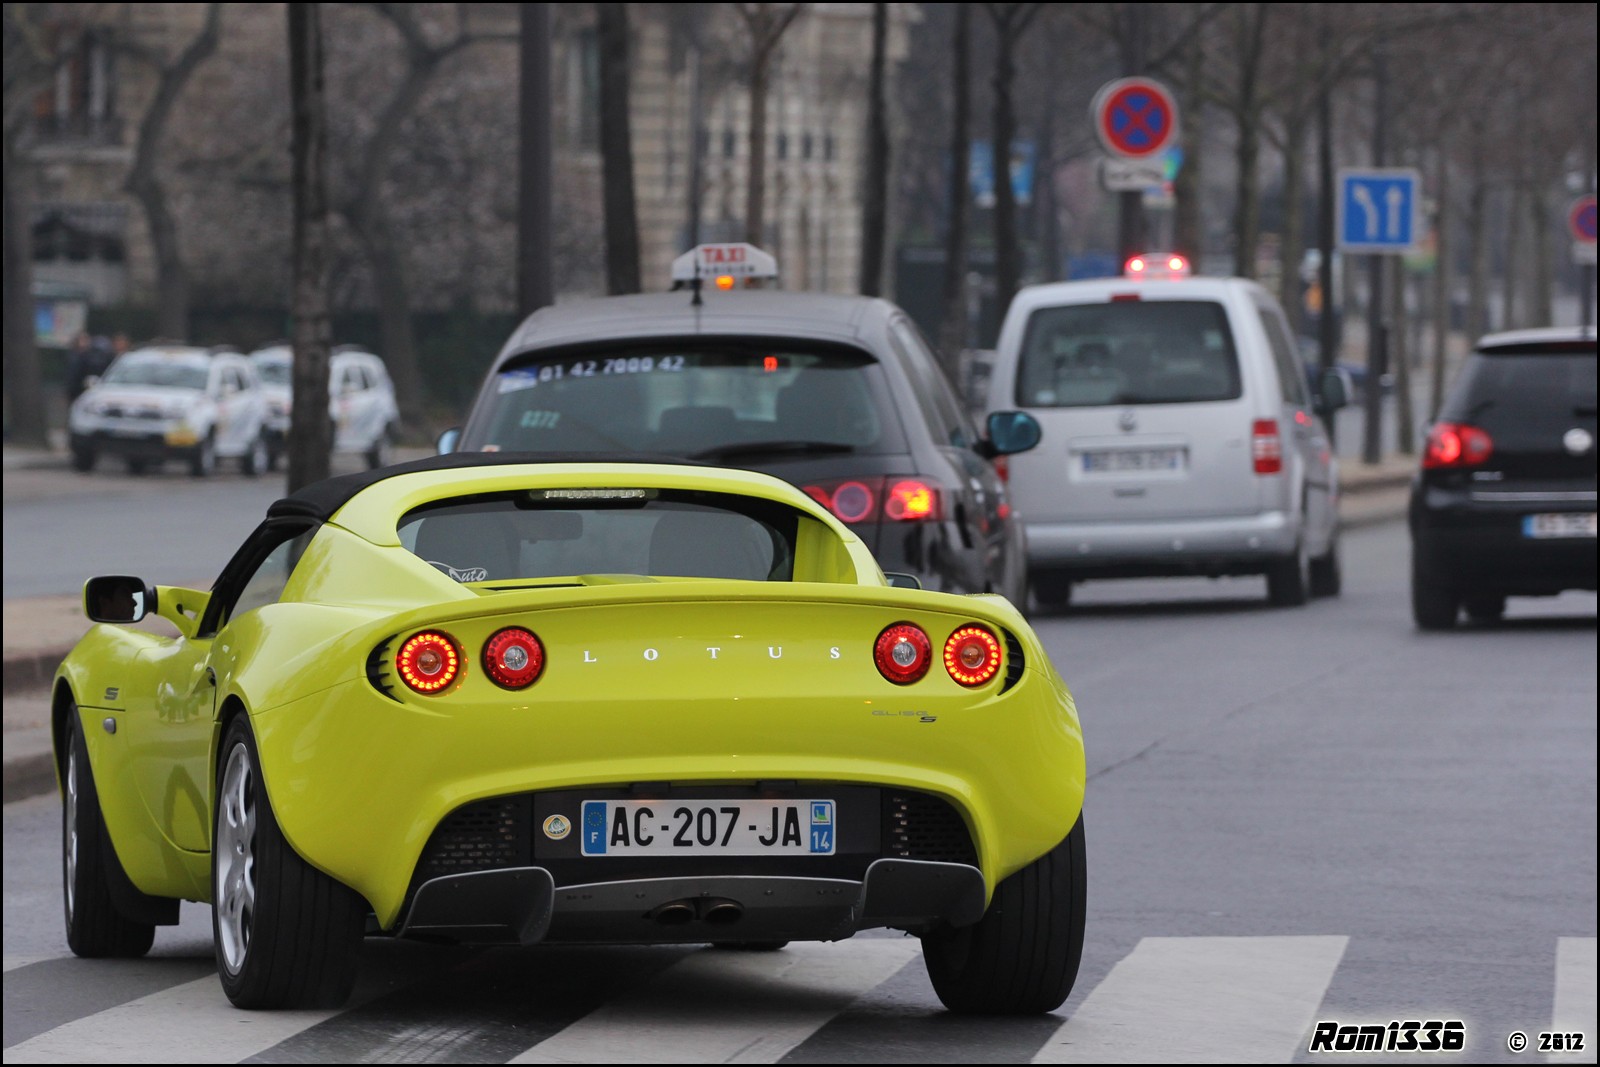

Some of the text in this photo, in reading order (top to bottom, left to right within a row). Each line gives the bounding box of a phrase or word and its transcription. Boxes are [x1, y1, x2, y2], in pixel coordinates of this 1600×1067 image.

[702, 247, 746, 263] TAXI
[540, 365, 563, 382] 01
[570, 361, 597, 377] 42
[602, 357, 653, 374] 7000
[657, 355, 685, 372] 42
[583, 646, 841, 663] LOTUS
[104, 687, 119, 700] S
[591, 832, 599, 843] F
[812, 831, 830, 849] 14
